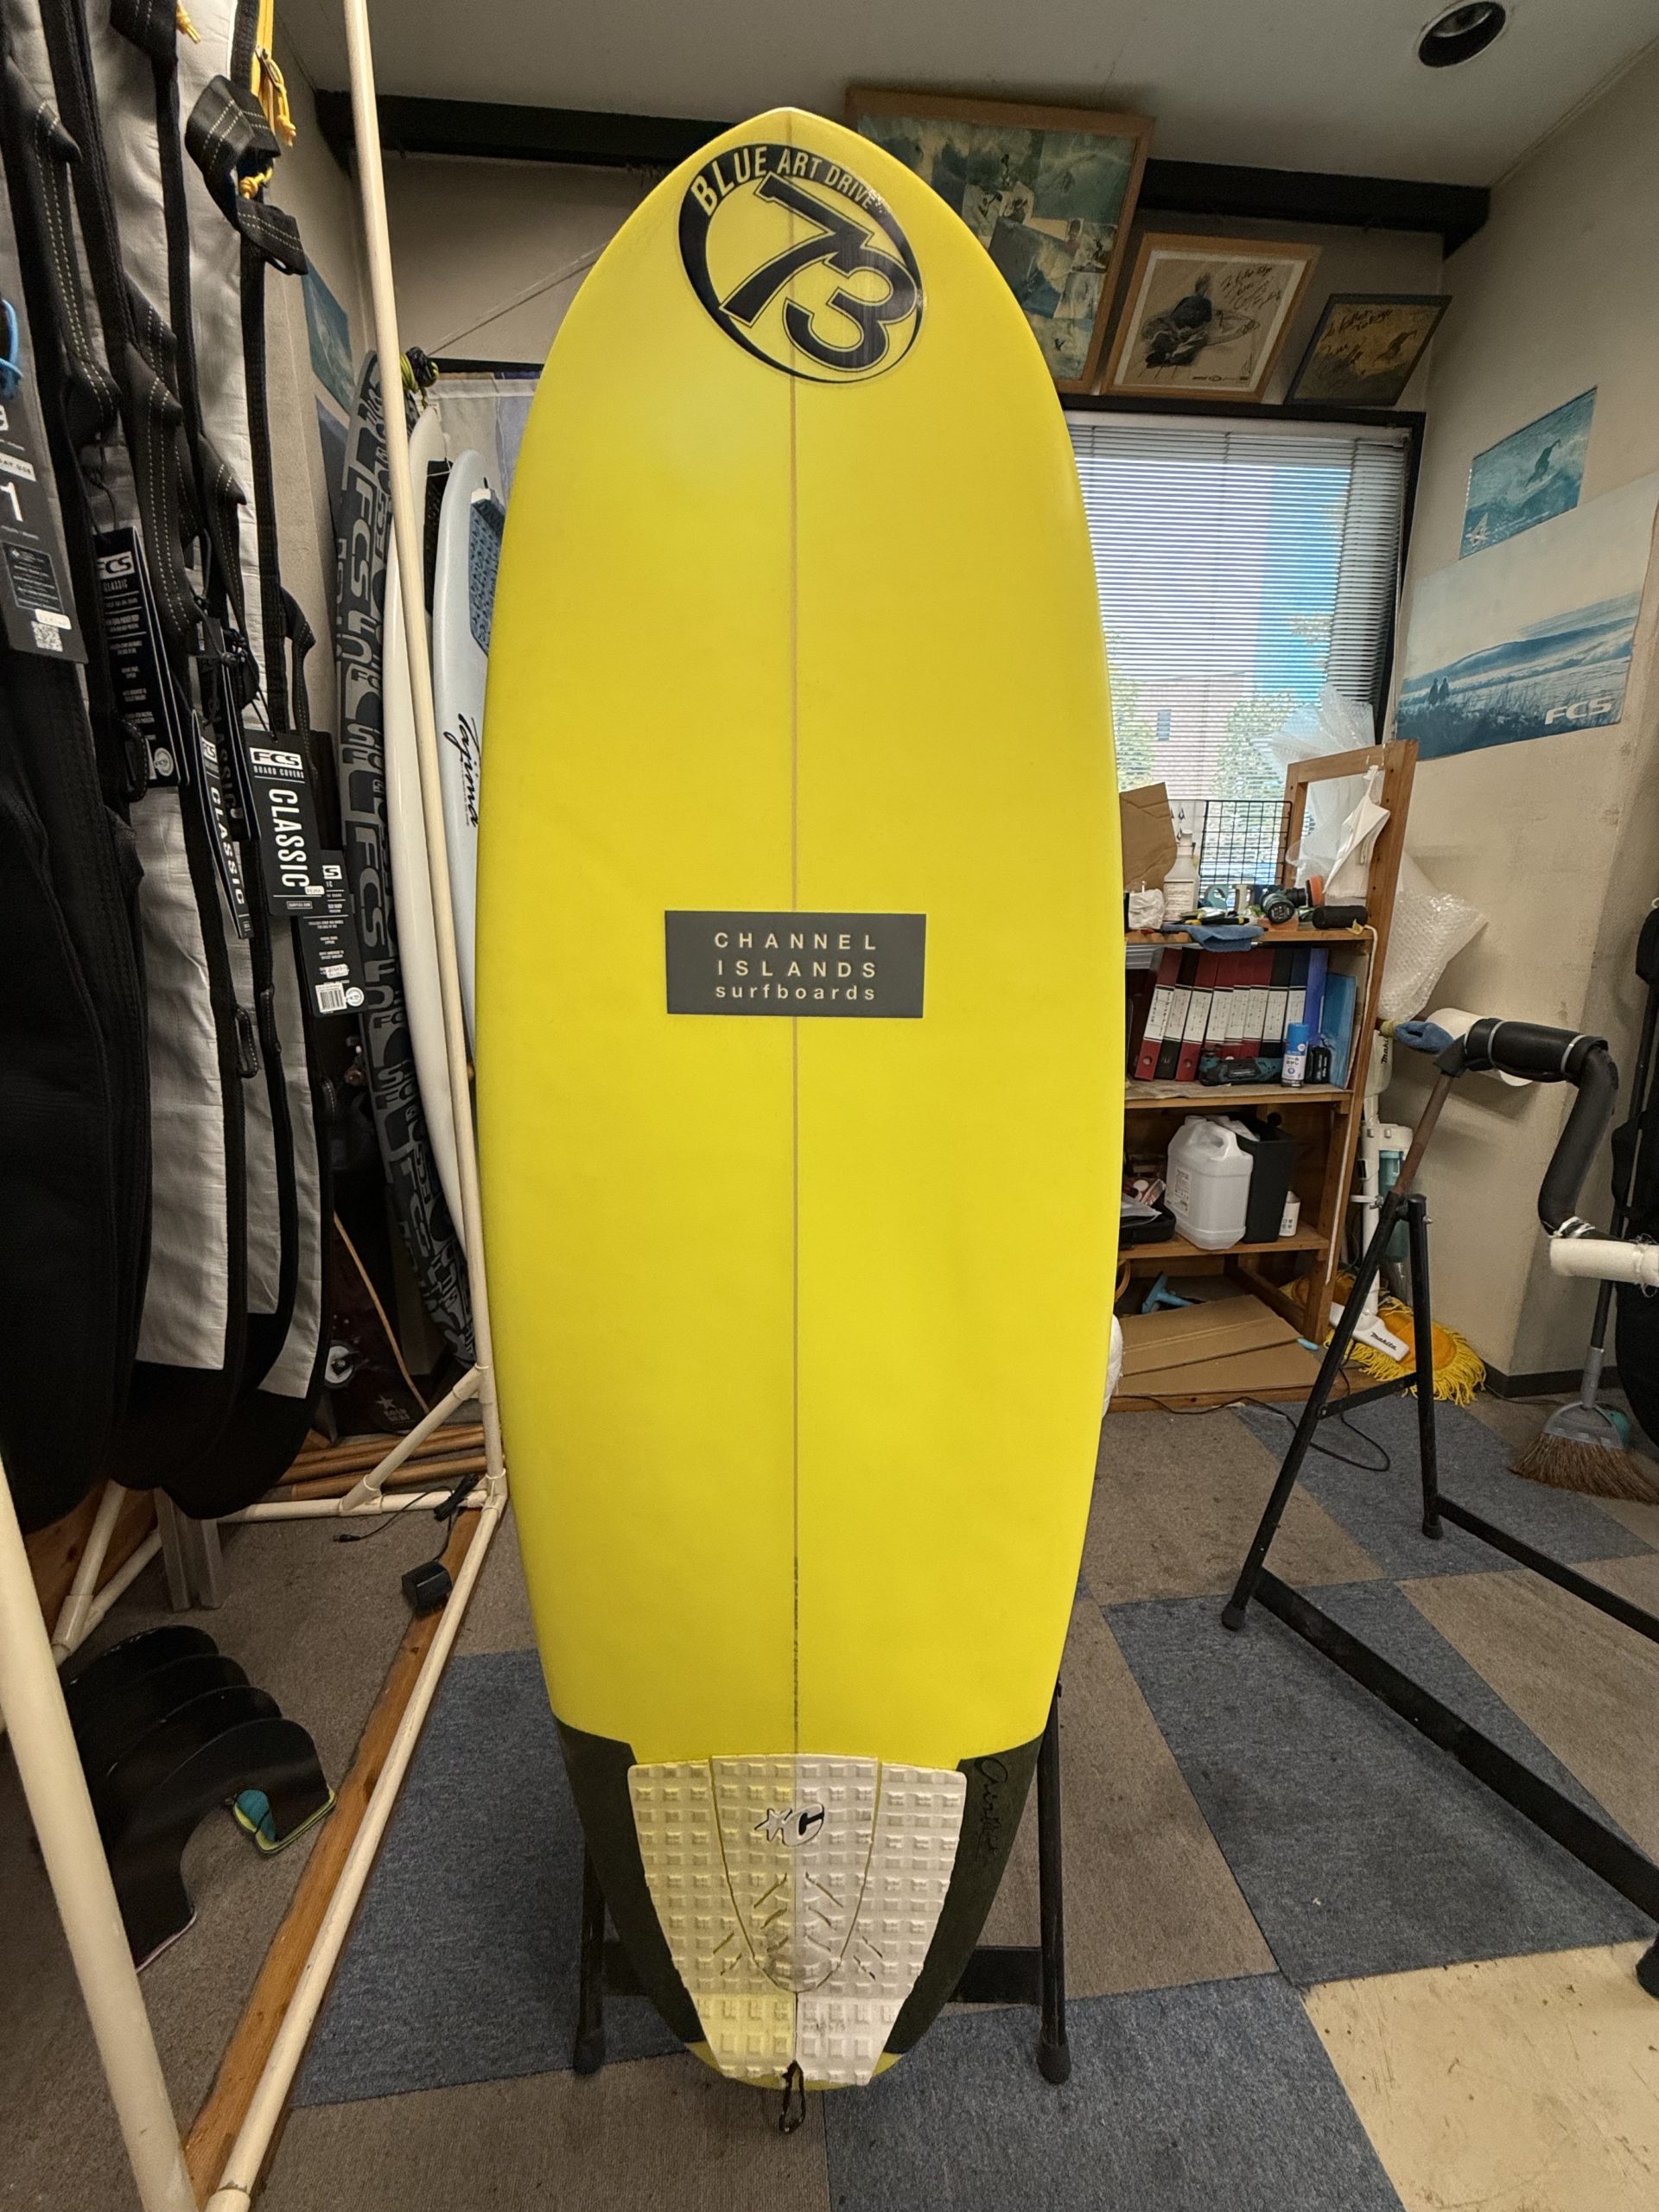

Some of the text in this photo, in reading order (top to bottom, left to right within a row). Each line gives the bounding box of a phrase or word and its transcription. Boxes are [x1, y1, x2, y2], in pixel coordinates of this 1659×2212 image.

[691, 146, 874, 216] BLUE ART DRIVE
[719, 171, 918, 373] 73
[1544, 695, 1613, 725] FCS
[253, 751, 300, 767] FCS
[253, 766, 304, 779] BOARD COVERS
[210, 786, 245, 905] CLASSIC
[269, 788, 310, 887] CLASSIC
[714, 932, 876, 950] CHANNEL
[717, 960, 876, 978] ISLANDS
[715, 984, 874, 1001] surfboards
